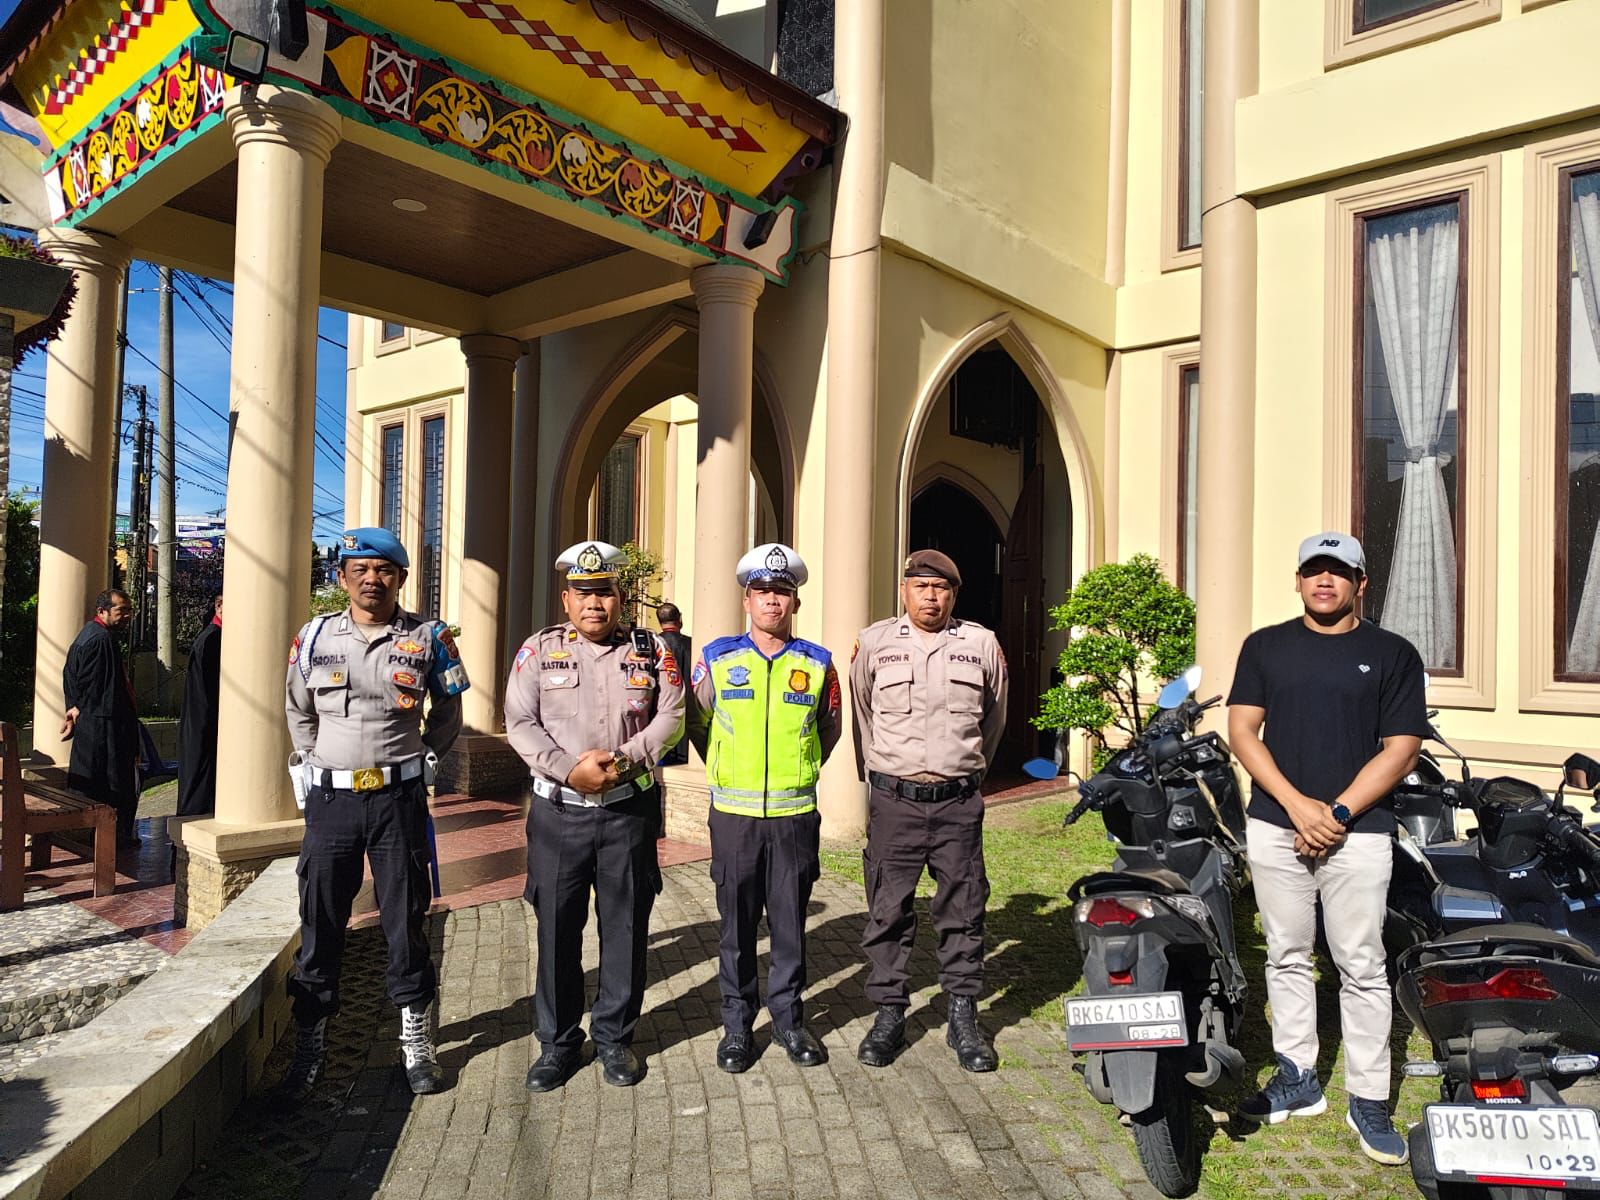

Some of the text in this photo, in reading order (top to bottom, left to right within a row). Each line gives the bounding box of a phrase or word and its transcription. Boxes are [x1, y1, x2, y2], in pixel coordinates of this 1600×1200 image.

[903, 653, 910, 662] R
[949, 654, 982, 665] POLRI
[787, 694, 811, 704] POLRI
[1430, 1111, 1590, 1141] BK5870 SAL
